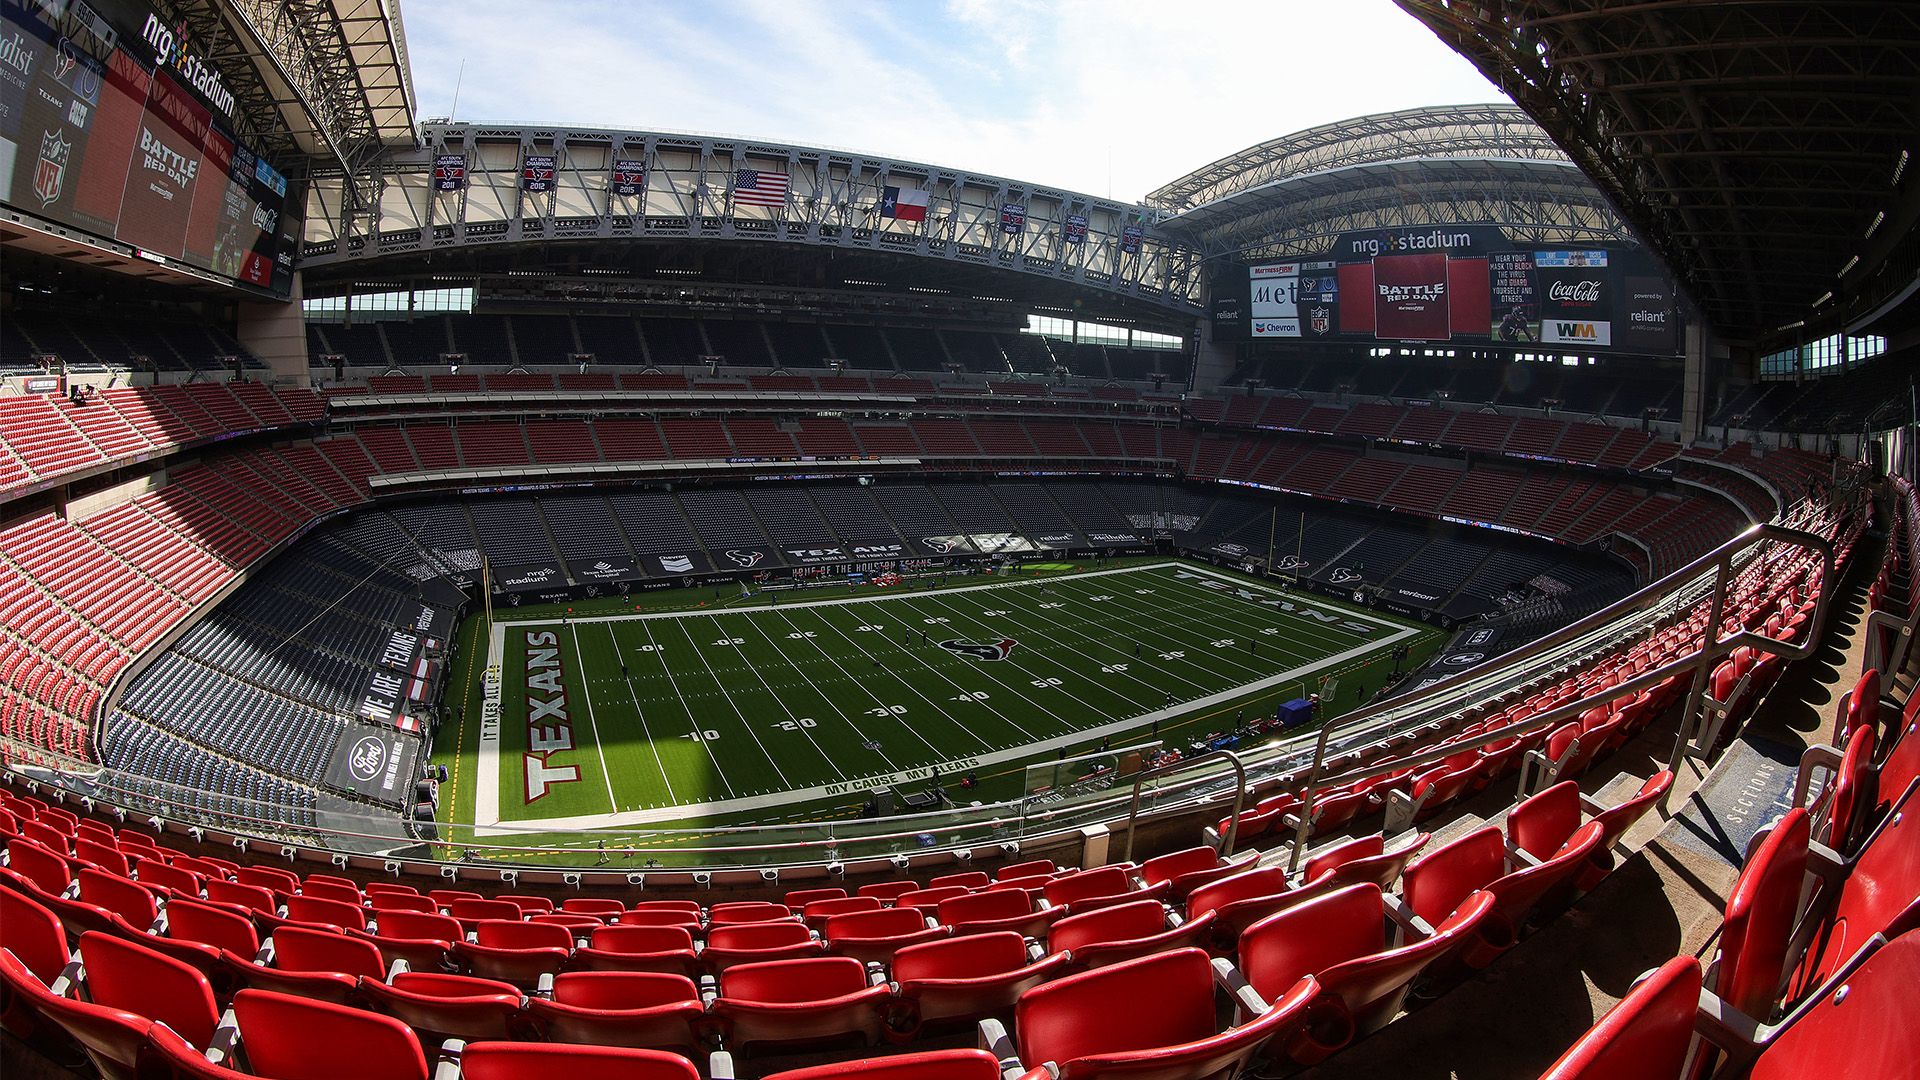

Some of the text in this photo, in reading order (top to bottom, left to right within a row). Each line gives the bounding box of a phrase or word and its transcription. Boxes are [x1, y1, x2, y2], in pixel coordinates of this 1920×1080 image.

[142, 12, 235, 118] nrg stadium
[39, 88, 63, 108] TEXANS
[140, 126, 198, 178] BATTLE
[144, 154, 188, 189] RED DAY
[36, 159, 62, 199] NFL
[1353, 230, 1470, 256] nrg stadium
[1379, 283, 1444, 295] BATTLE
[1217, 311, 1238, 319] reliant
[1631, 310, 1664, 322] reliant
[1267, 324, 1295, 332] Chevron
[1312, 318, 1327, 329] NFL
[1557, 323, 1596, 338] WM
[977, 535, 1021, 549] BHP
[787, 548, 842, 557] TEX
[821, 566, 831, 574] OF
[836, 564, 851, 574] THE
[856, 561, 895, 572] HOUSTON
[506, 576, 548, 585] stadium
[1174, 570, 1377, 632] TEXANS
[1399, 589, 1438, 601] verizon
[1388, 604, 1411, 614] TEXANS
[1101, 664, 1128, 673] 40
[360, 632, 417, 720] WE ARE TEXANS
[1030, 677, 1063, 689] 50
[486, 686, 499, 699] ALL
[959, 691, 990, 702] 40
[484, 702, 498, 728] TAKES
[872, 705, 908, 717] 30
[523, 630, 582, 806] TEXANS
[780, 717, 817, 731] 20
[689, 729, 720, 742] 10
[353, 742, 382, 774] Ford
[824, 783, 850, 796] MY
[852, 774, 899, 789] CAUSE
[905, 768, 929, 780] MY
[1727, 762, 1775, 824] SECTIONS
